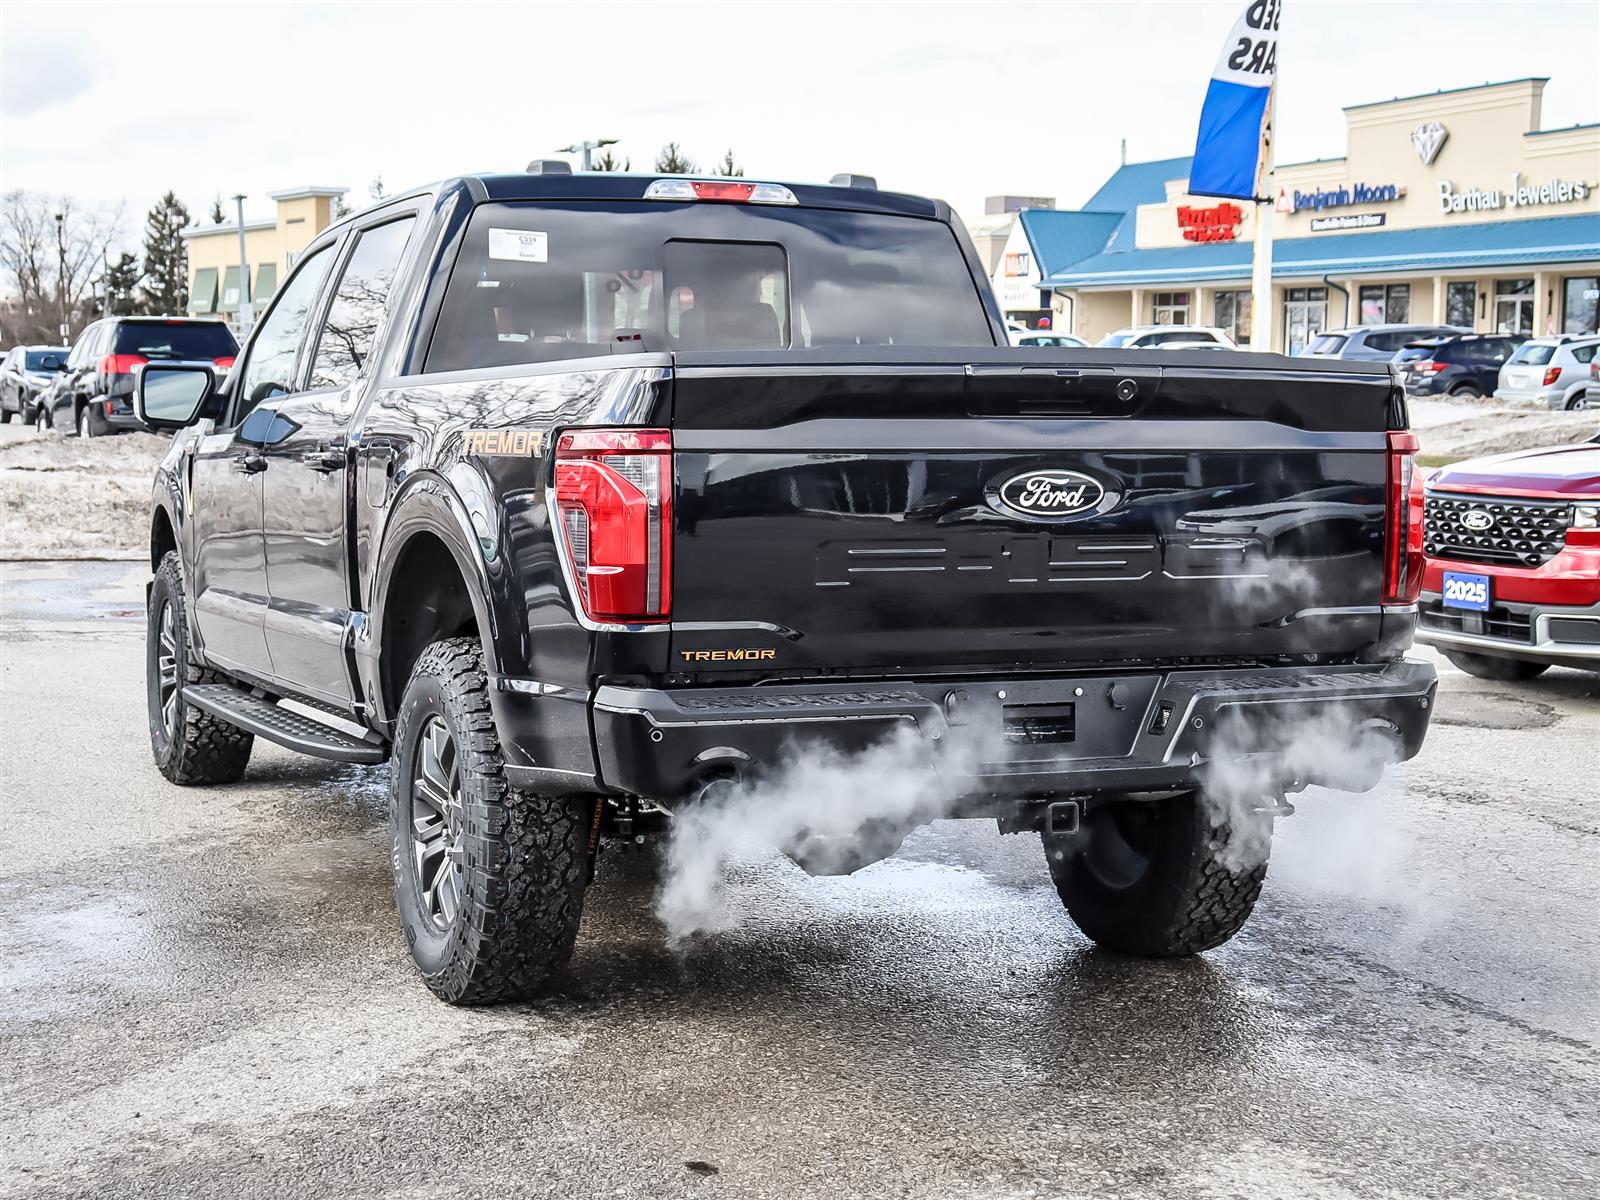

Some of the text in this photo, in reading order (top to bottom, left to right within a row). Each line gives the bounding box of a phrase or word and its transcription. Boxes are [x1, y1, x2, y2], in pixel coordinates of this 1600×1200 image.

[1294, 183, 1395, 212] Benjamin Moore
[1439, 173, 1586, 214] Barthau Jewellers
[461, 431, 543, 458] TREMOR
[1020, 477, 1086, 507] Ford
[1465, 512, 1488, 527] Ford
[1445, 580, 1487, 603] 2025
[681, 648, 777, 661] TREMOR
